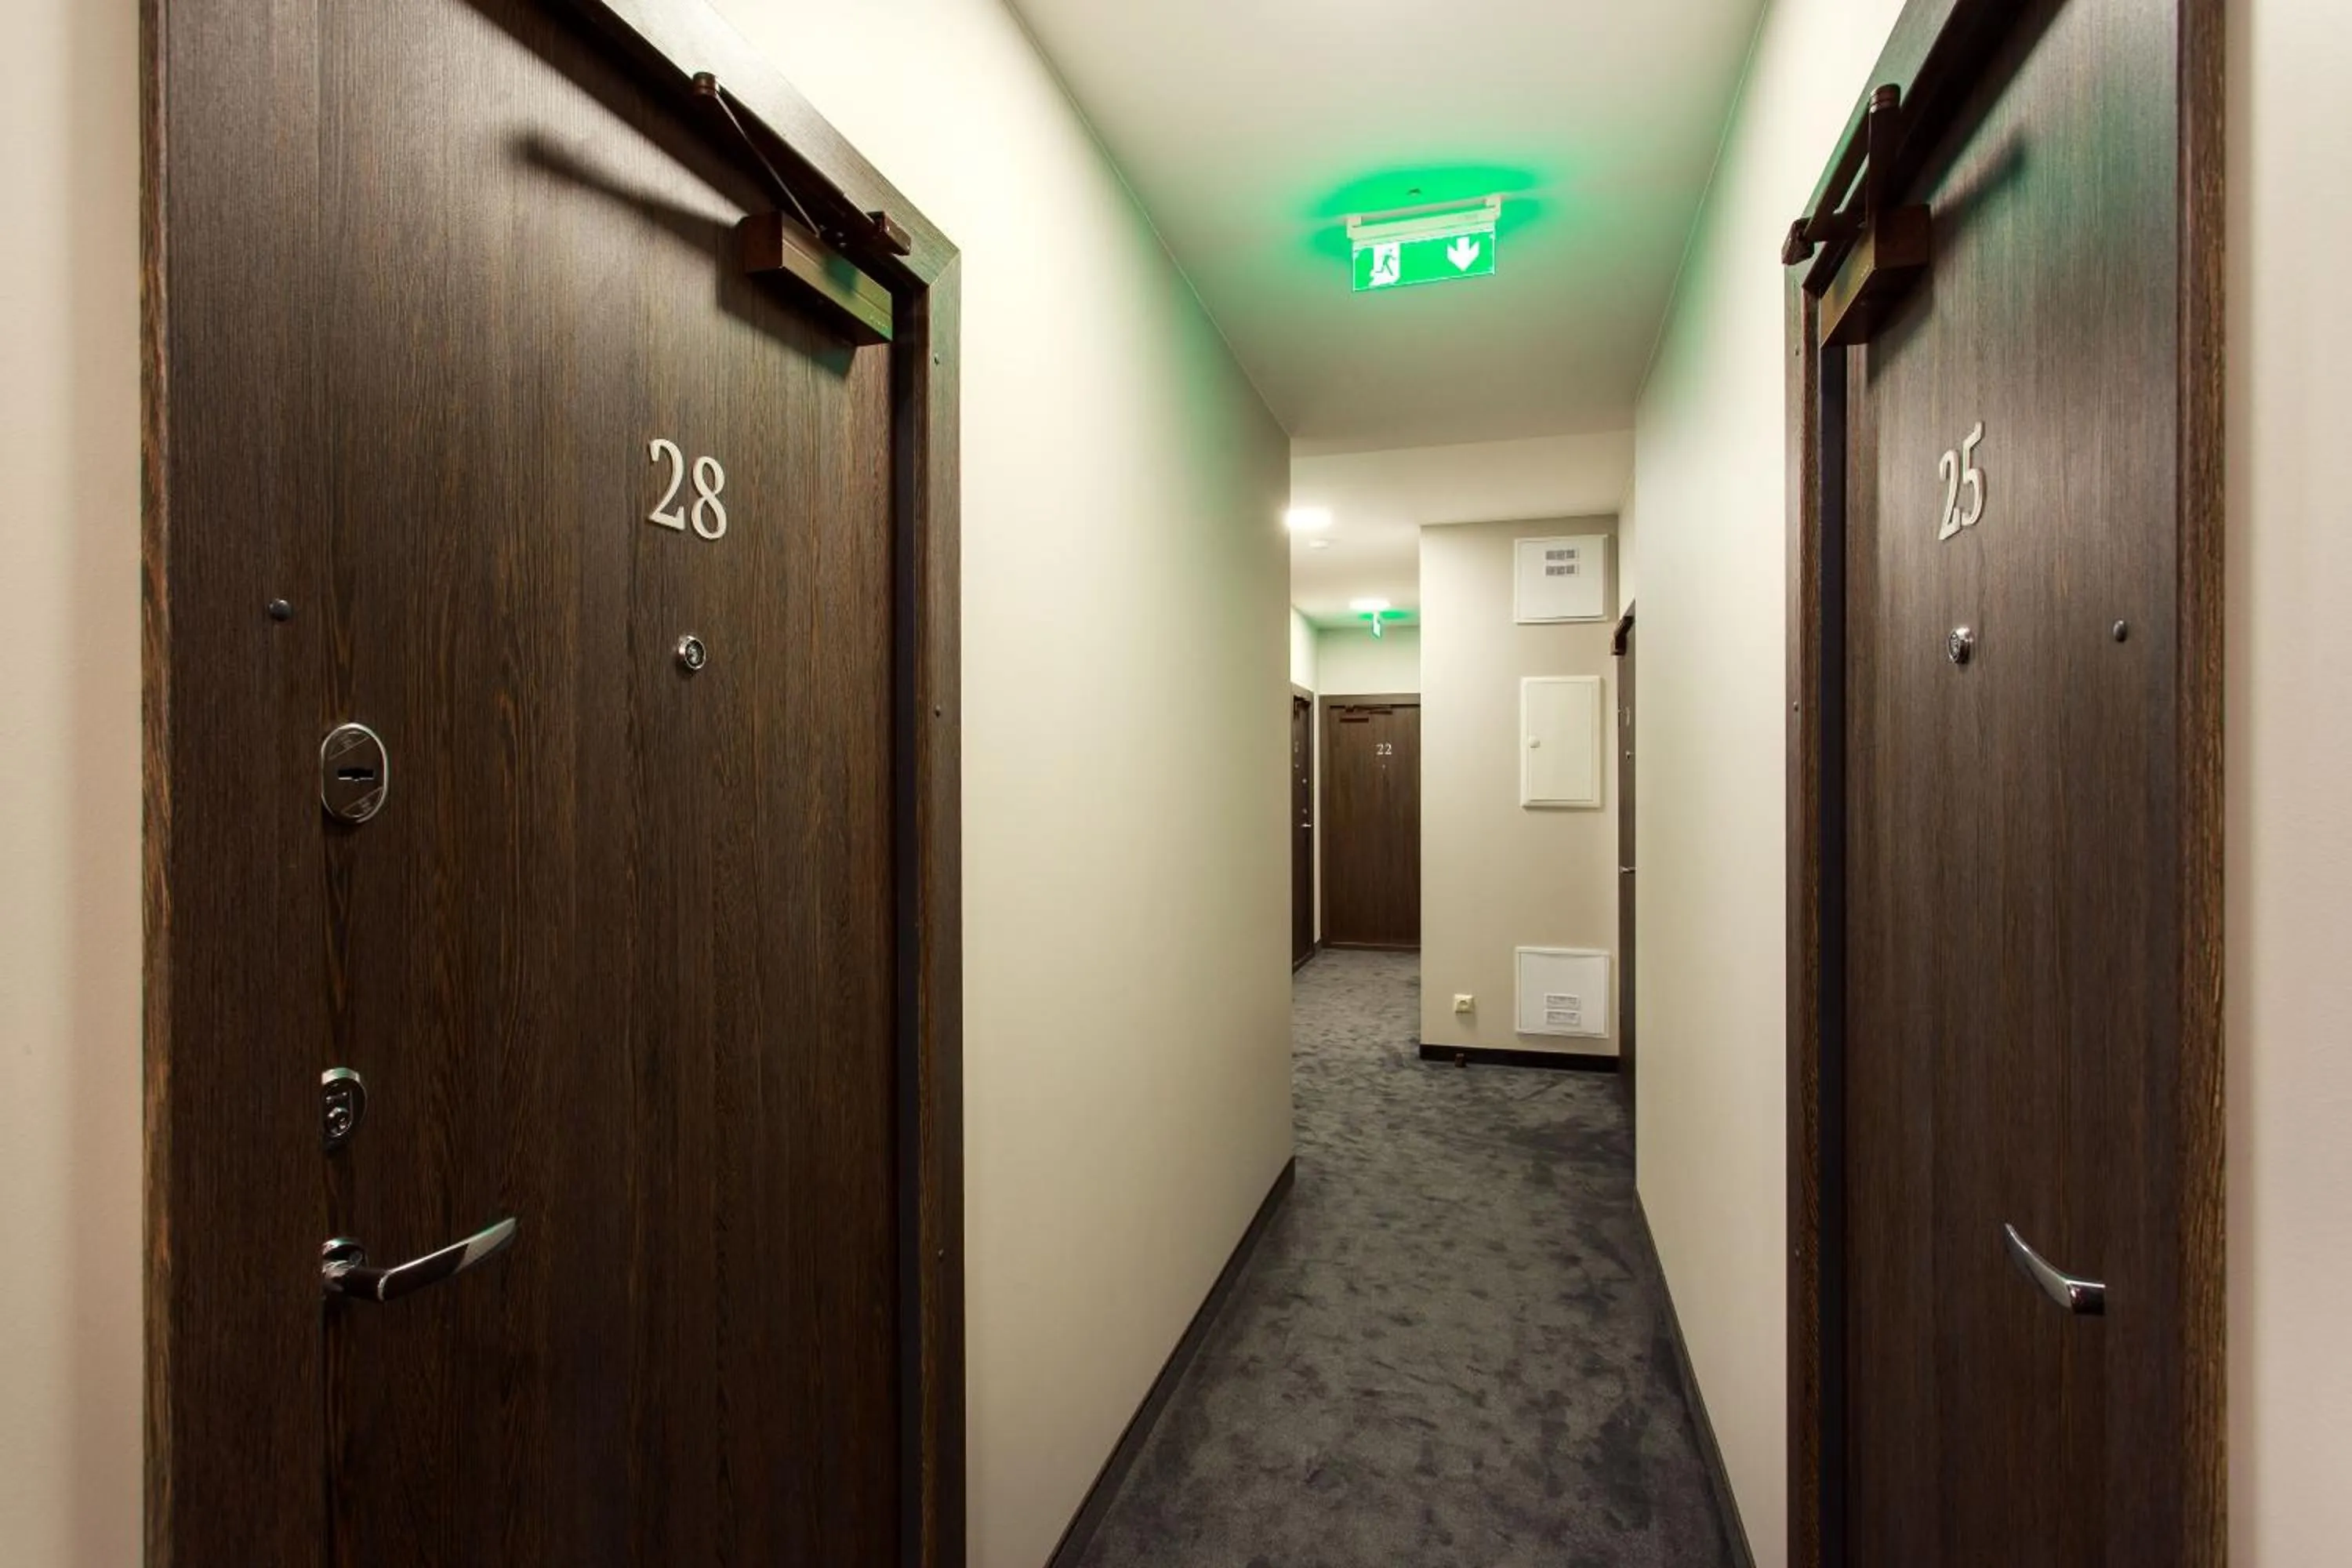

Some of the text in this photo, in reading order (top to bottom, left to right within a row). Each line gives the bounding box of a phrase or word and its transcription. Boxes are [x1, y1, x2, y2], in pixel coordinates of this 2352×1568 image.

[649, 438, 728, 539] 28
[1938, 421, 1985, 540] 25
[1376, 742, 1392, 755] 22
